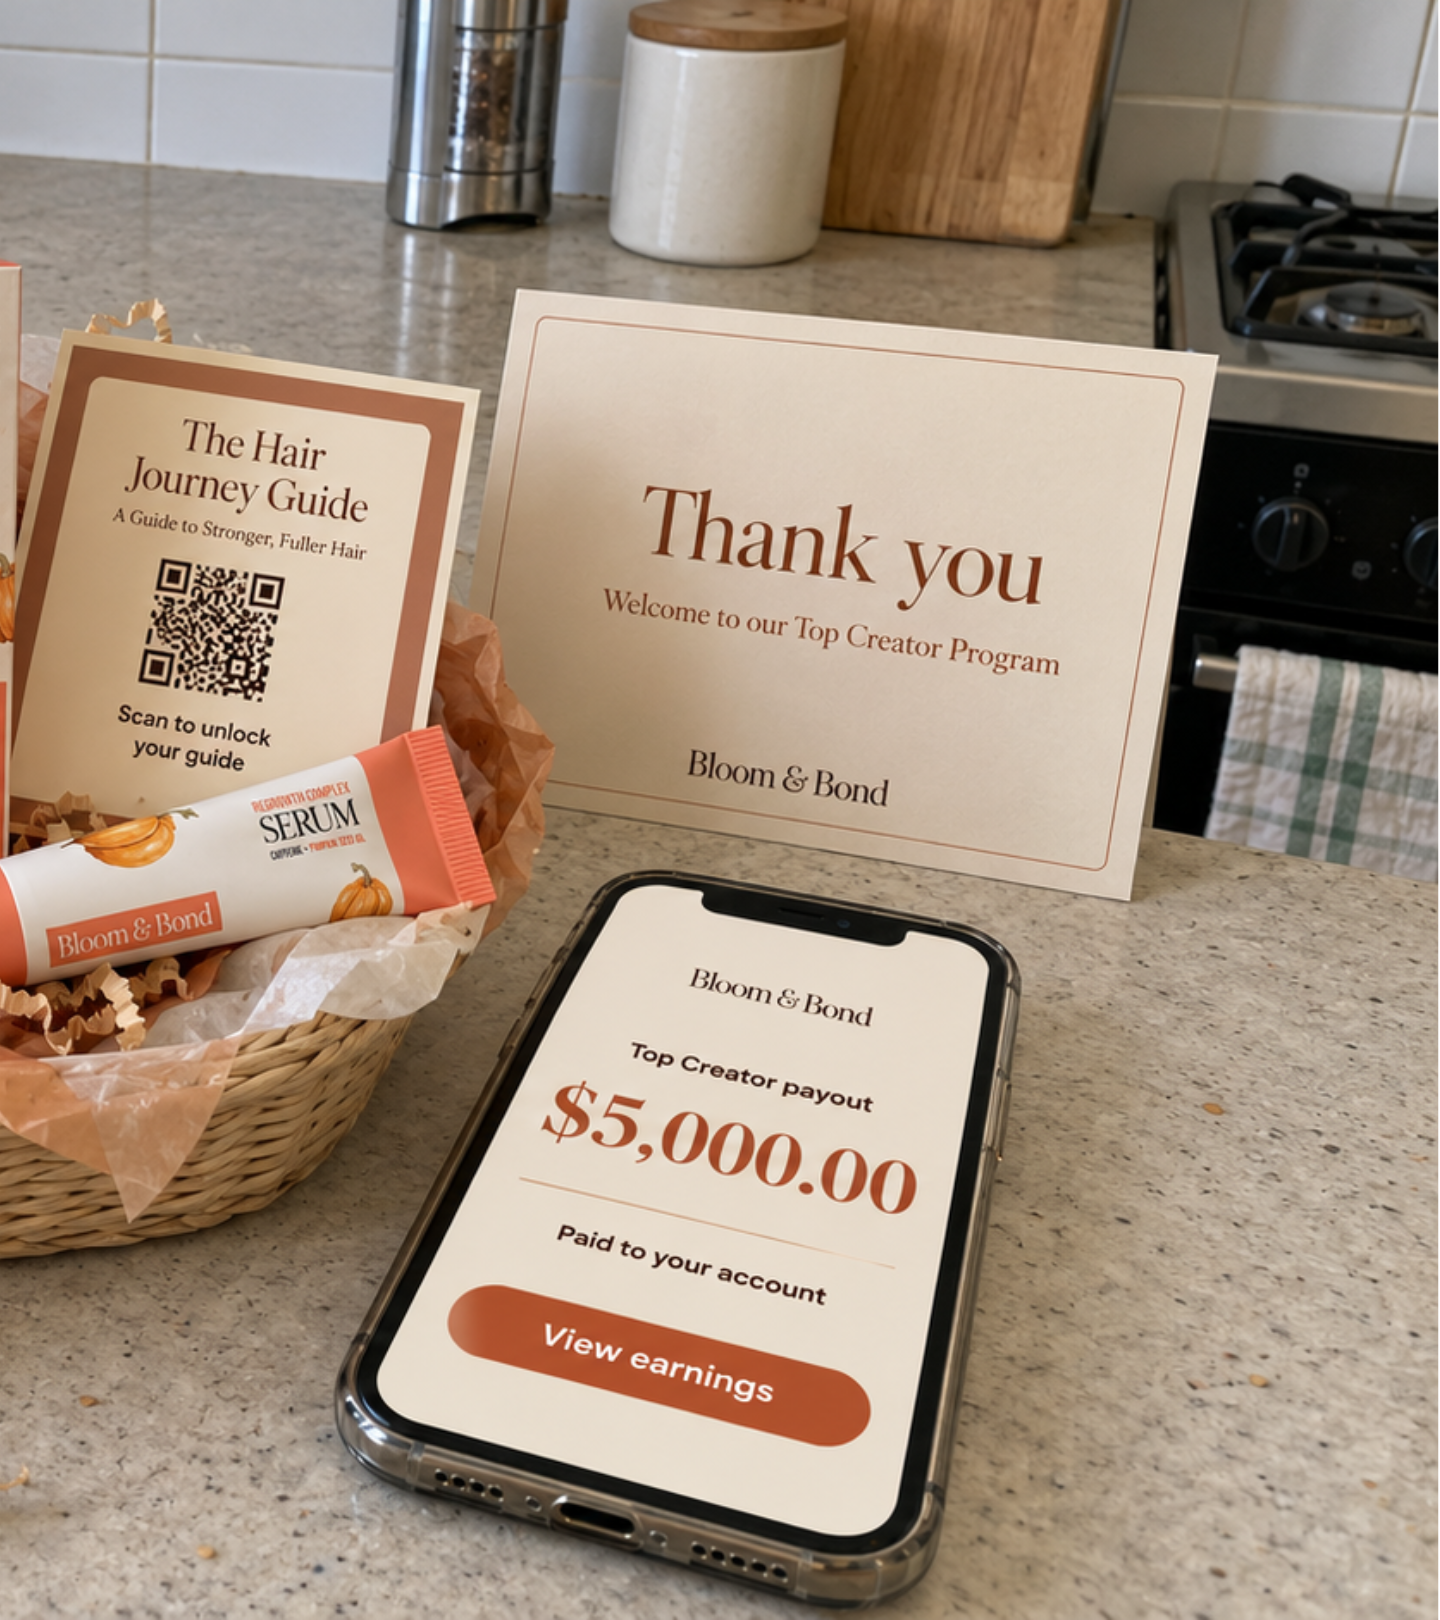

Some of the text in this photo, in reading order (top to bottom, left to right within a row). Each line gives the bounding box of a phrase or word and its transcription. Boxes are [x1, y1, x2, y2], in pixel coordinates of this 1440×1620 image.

[182, 418, 326, 471] The Hair
[124, 455, 369, 523] Journey Guide
[112, 508, 367, 561] A Guide to Stronger, Fuller Hair
[642, 484, 1044, 611] Thank you
[602, 588, 1060, 676] Welcome to our Top Creator Program
[118, 704, 271, 747] Scan to unlock
[133, 737, 245, 772] your guide
[687, 749, 889, 808] Bloom & Bond
[259, 798, 361, 843] SERUM
[57, 901, 213, 959] Bloom & Bond
[689, 966, 874, 1028] Bloom & Bond
[629, 1041, 874, 1114] Top Creator payout
[540, 1080, 919, 1215] $5,000.00
[556, 1224, 827, 1307] Paid to your account
[543, 1323, 775, 1404] View earnings
